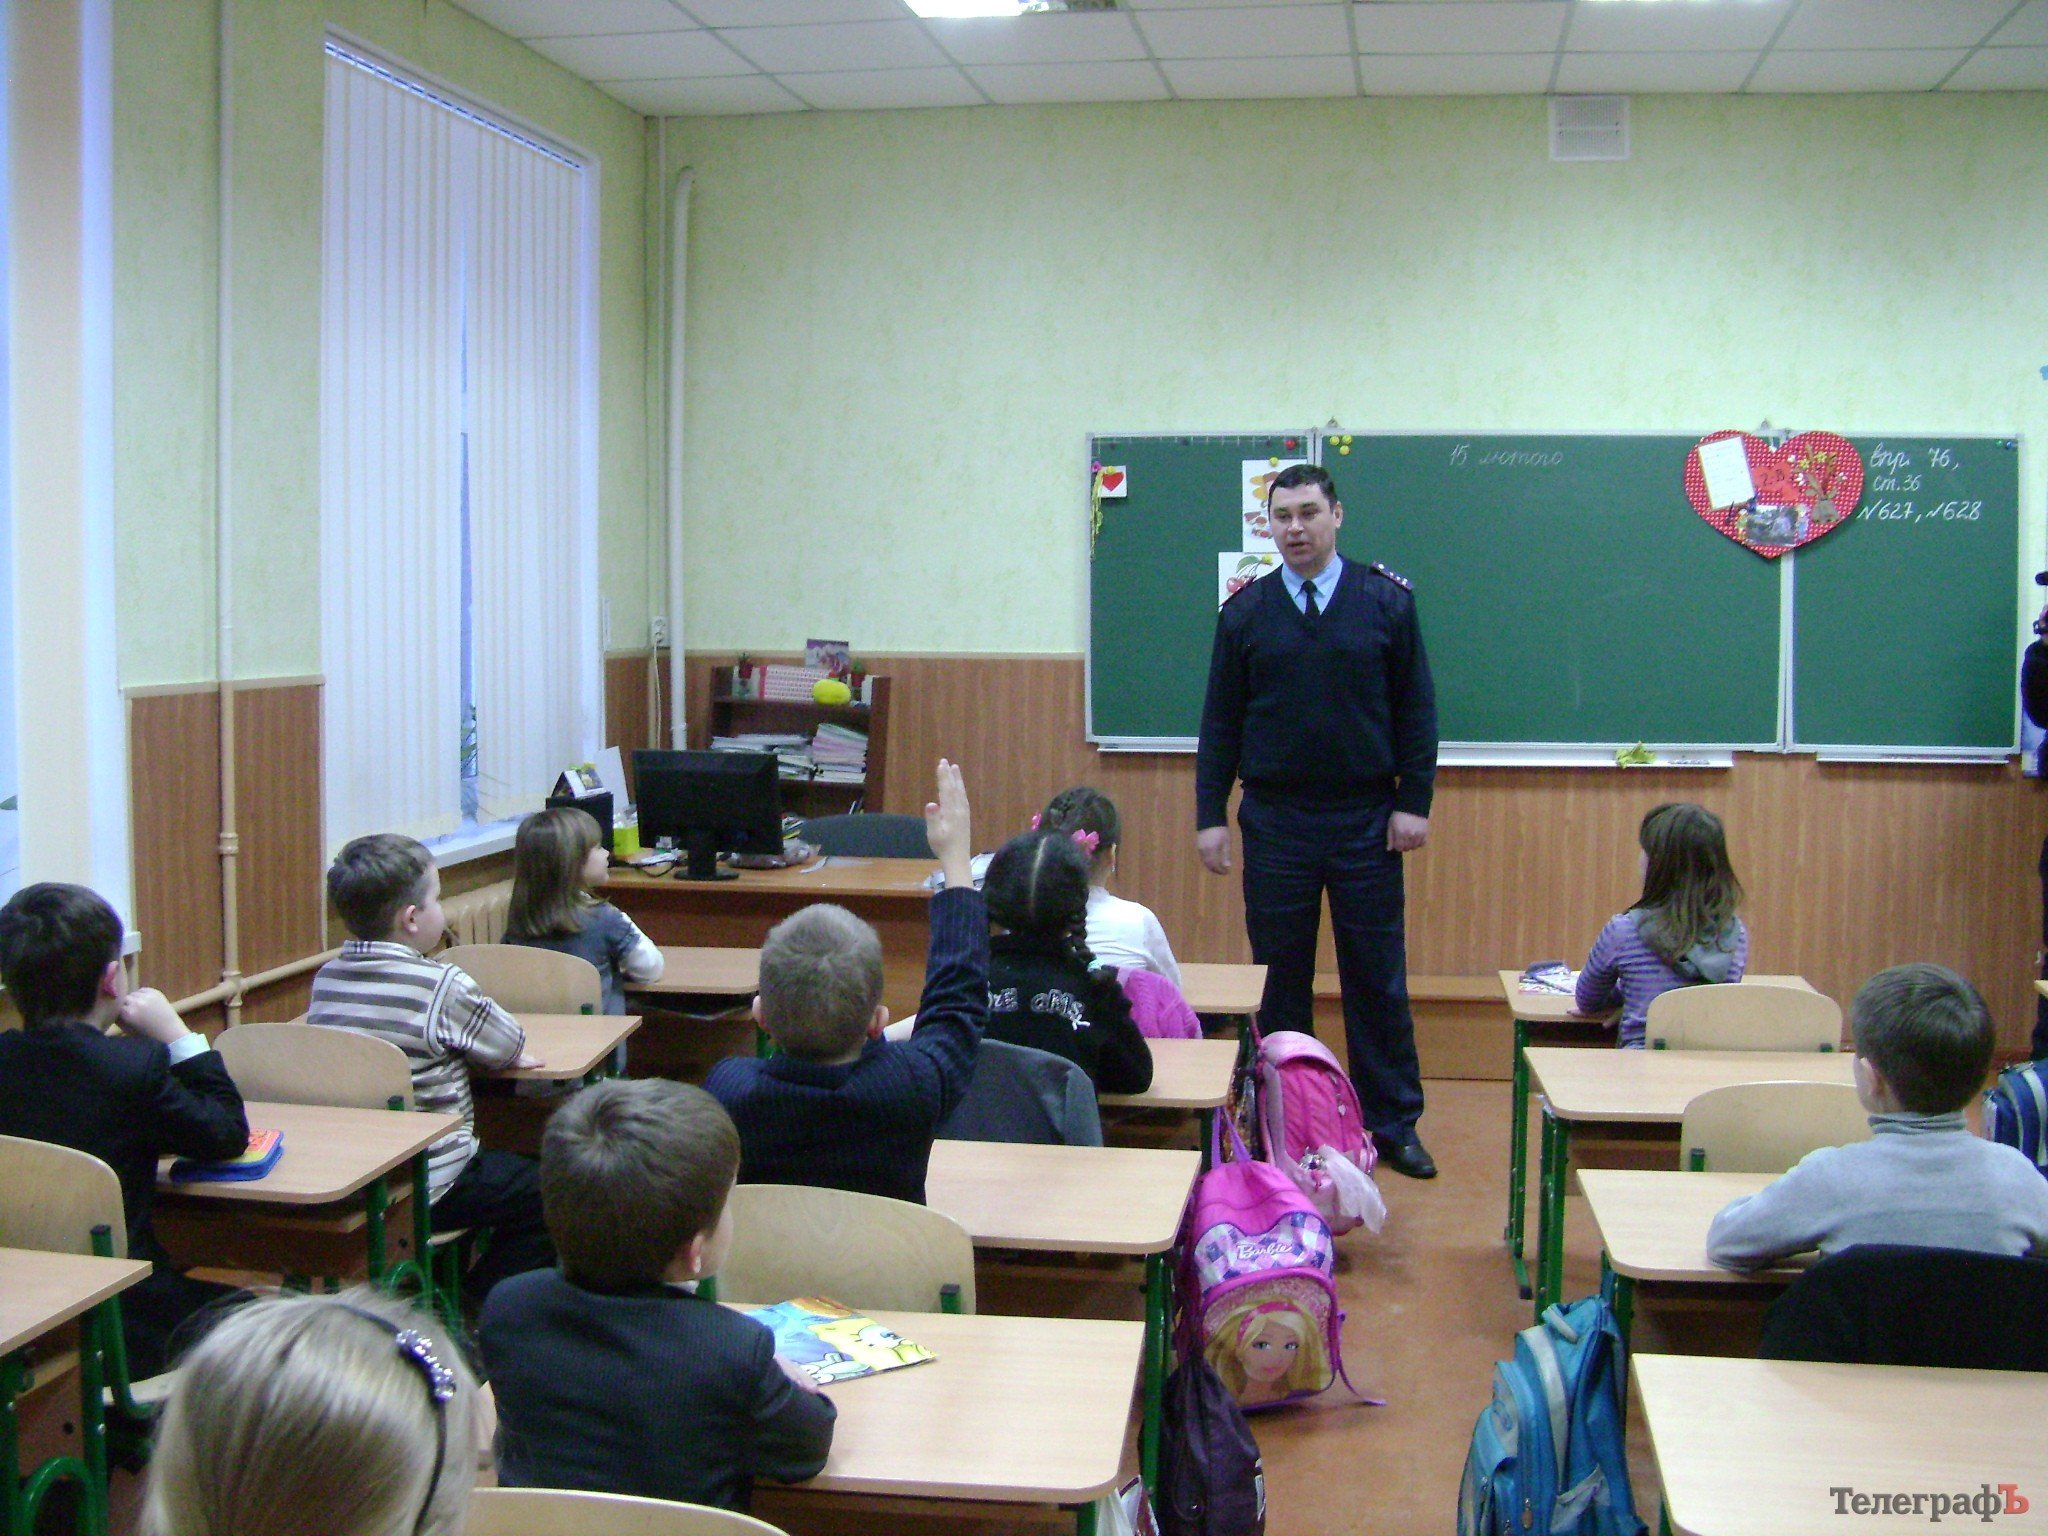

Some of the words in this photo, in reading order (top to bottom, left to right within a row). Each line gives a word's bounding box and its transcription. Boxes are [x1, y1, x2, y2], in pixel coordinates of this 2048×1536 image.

[1449, 443, 1470, 466] 15
[1480, 450, 1564, 467] лютого
[1236, 1241, 1294, 1260] Barbie
